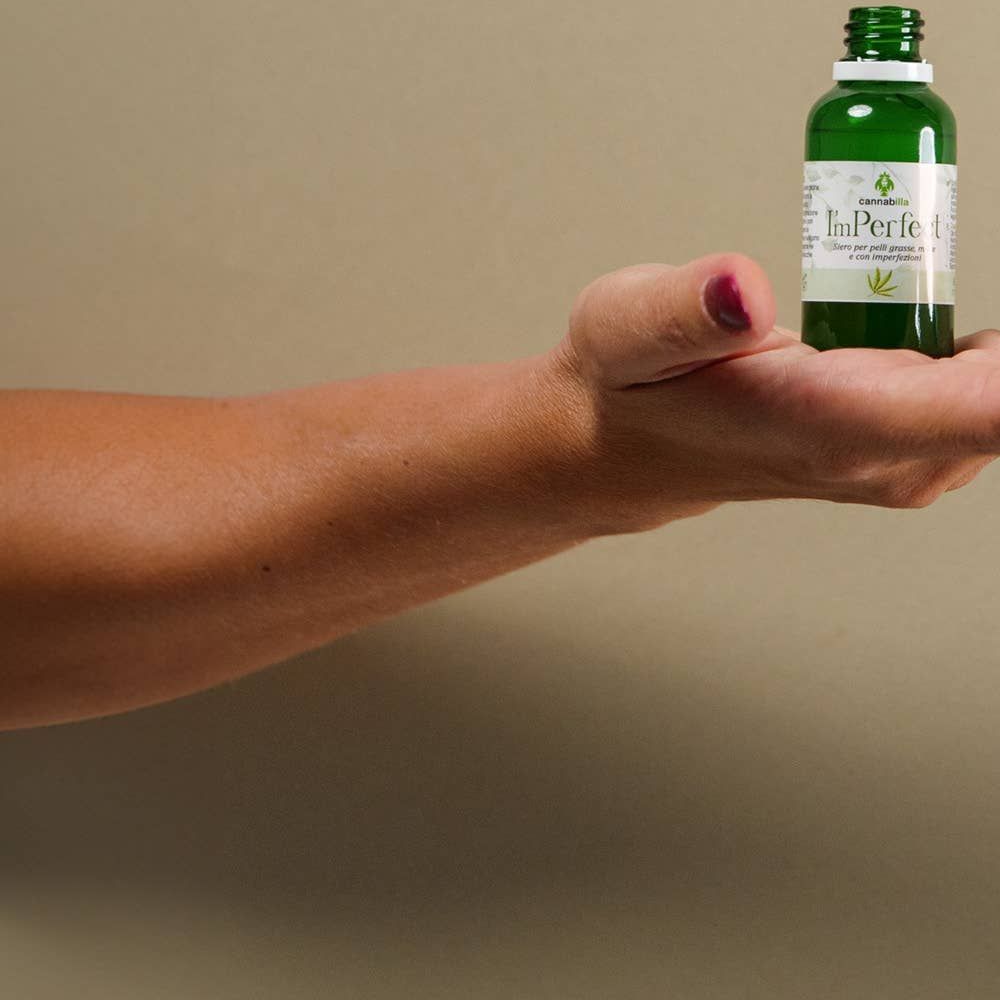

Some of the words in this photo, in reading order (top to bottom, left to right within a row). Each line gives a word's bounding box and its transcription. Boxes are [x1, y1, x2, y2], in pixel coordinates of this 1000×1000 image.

[858, 197, 909, 207] cannabilla
[827, 209, 941, 239] I'mPerfet
[832, 243, 852, 252] Siero
[854, 244, 867, 253] per
[869, 243, 887, 253] pelli
[855, 253, 870, 261] con
[871, 253, 922, 263] imperfezioni
